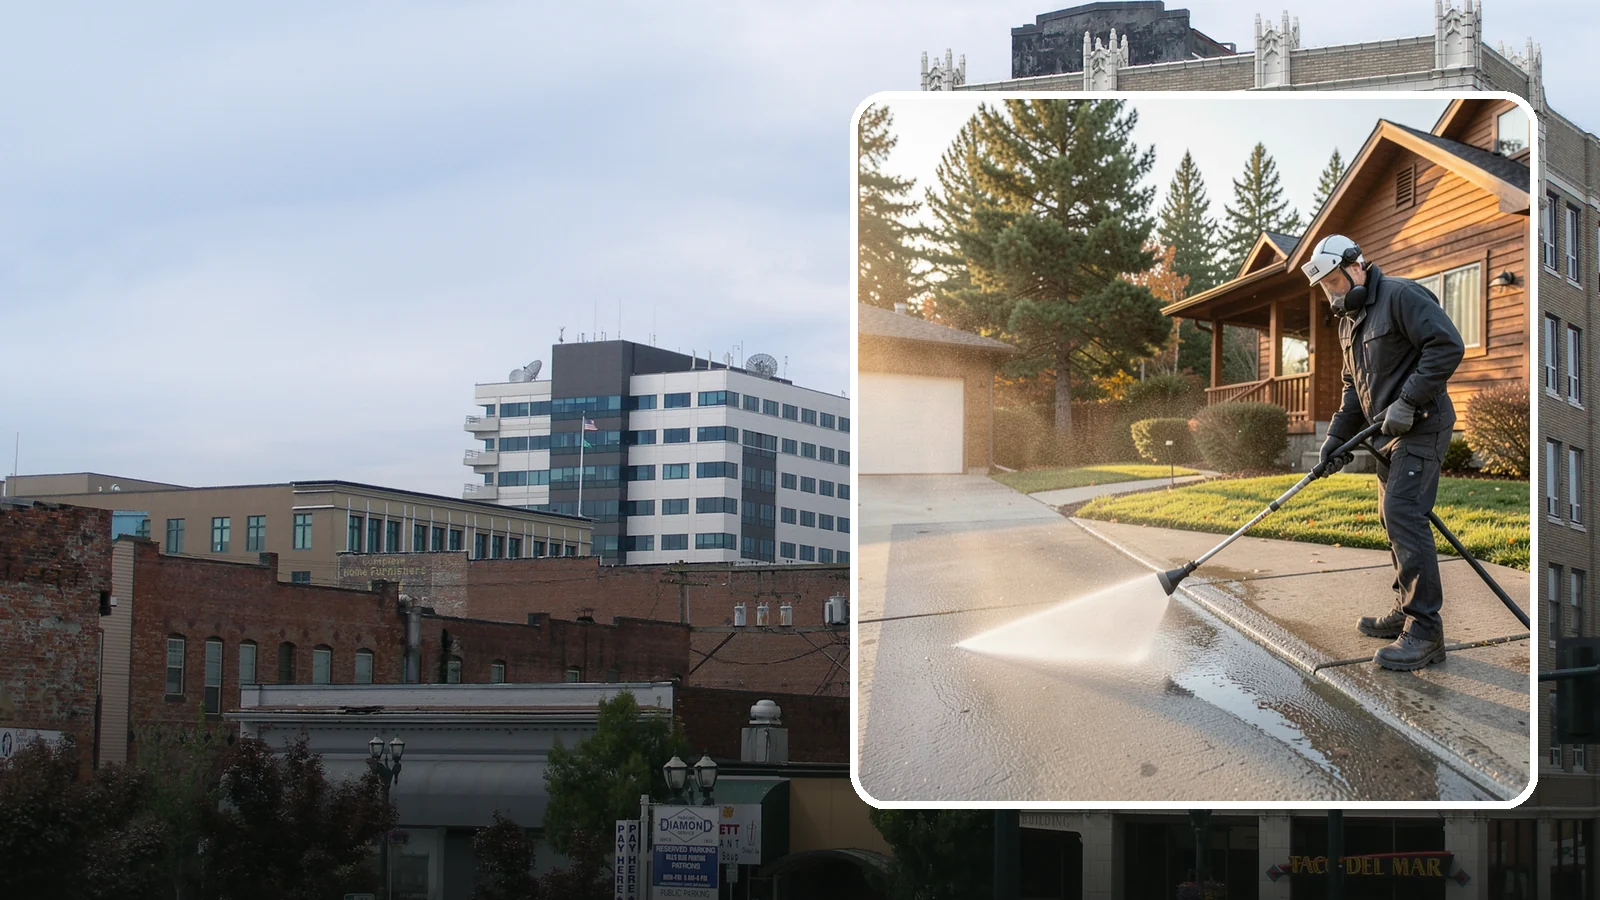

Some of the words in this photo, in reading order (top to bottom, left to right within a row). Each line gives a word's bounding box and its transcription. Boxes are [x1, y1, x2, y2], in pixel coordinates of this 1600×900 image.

[660, 818, 713, 832] DIAMOND
[1022, 815, 1070, 828] BUILDING
[617, 824, 625, 853] PAY
[628, 824, 637, 853] PAY
[656, 845, 688, 853] RESERVED
[689, 846, 716, 854] PARKING
[722, 852, 738, 862] Soup
[616, 855, 625, 894] HERE
[627, 855, 636, 894] HERE
[1345, 856, 1385, 876] DEL
[1392, 857, 1443, 877] MAR
[660, 888, 682, 897] PUBLIC
[683, 889, 710, 898] PARKING
